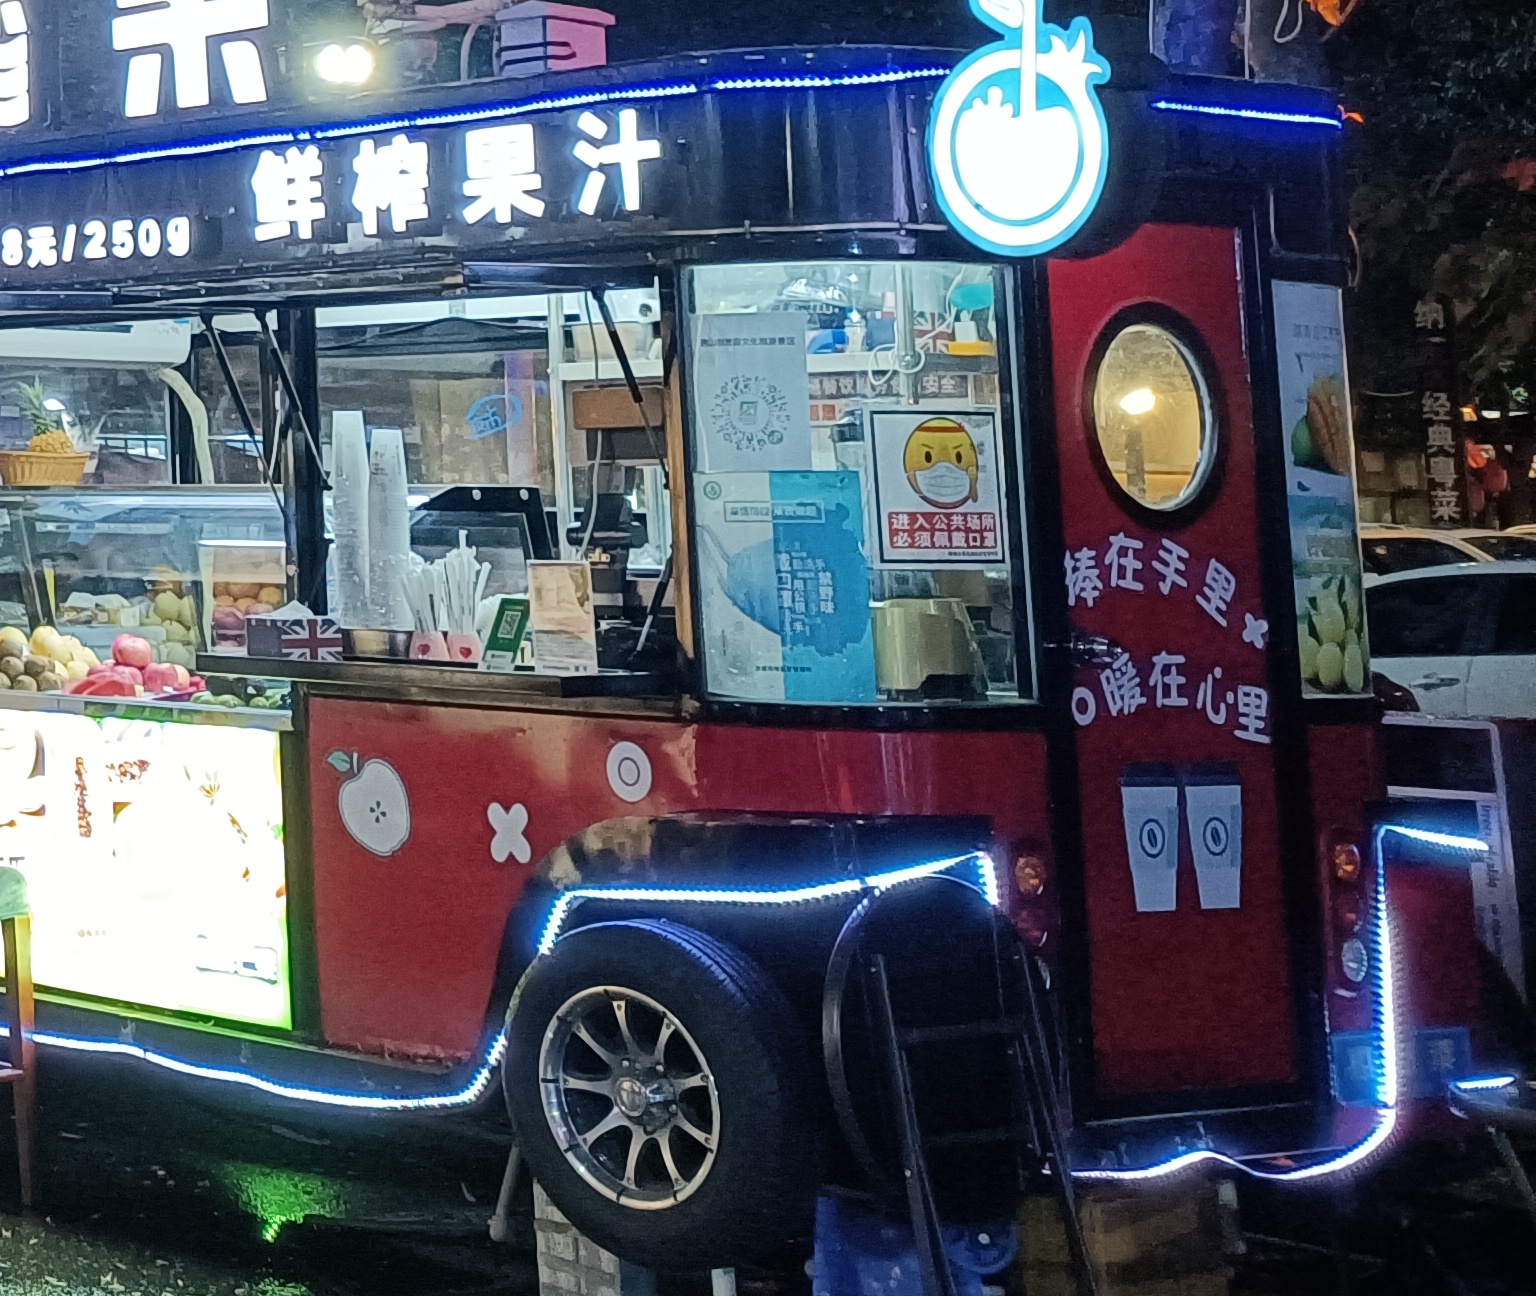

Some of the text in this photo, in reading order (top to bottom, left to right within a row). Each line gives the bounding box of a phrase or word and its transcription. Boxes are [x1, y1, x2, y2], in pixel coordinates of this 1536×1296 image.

[249, 108, 663, 242] 鲜榨果汁
[1421, 390, 1460, 522] 经典粤菜
[890, 513, 995, 531] 进入公共场所
[892, 530, 996, 548] 必须佩戴口罩
[1099, 650, 1273, 745] 暖在心里
